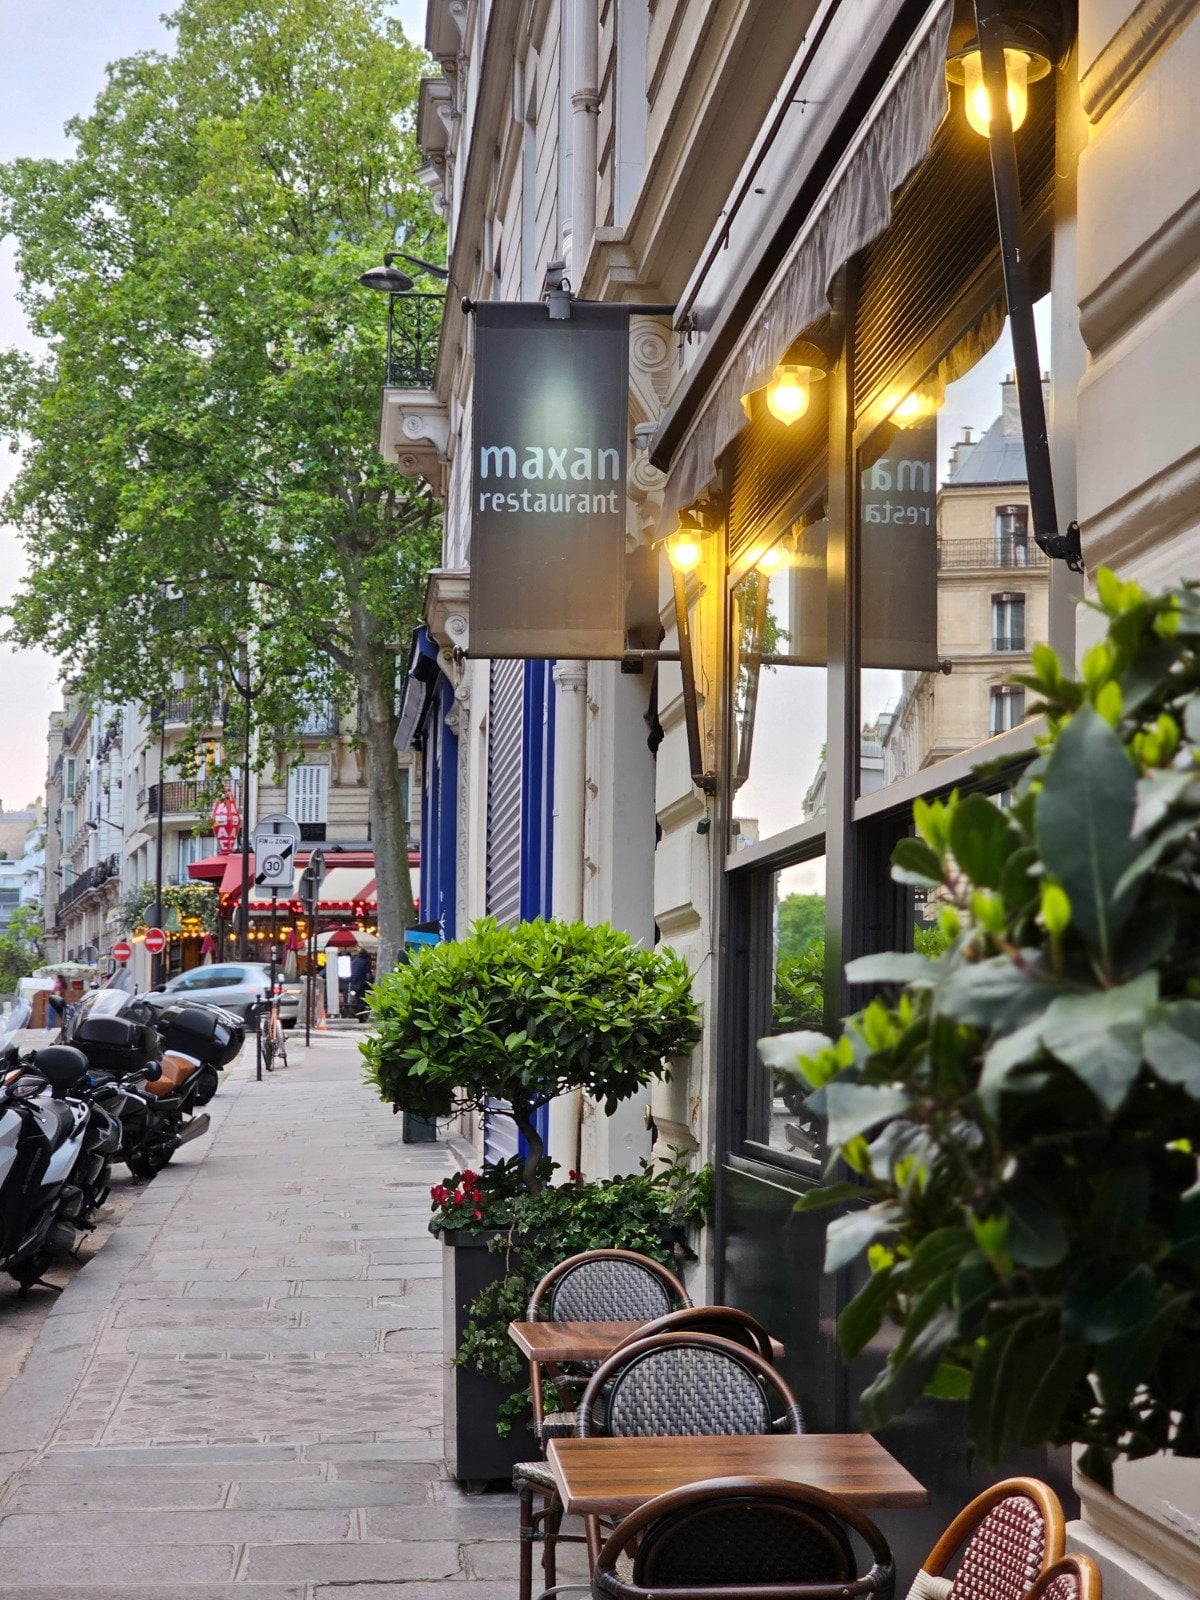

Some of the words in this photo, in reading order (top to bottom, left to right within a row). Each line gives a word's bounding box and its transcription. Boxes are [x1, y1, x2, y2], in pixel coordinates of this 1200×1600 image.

[480, 445, 620, 481] maxan
[479, 488, 620, 514] restaurant
[266, 861, 280, 871] 30
